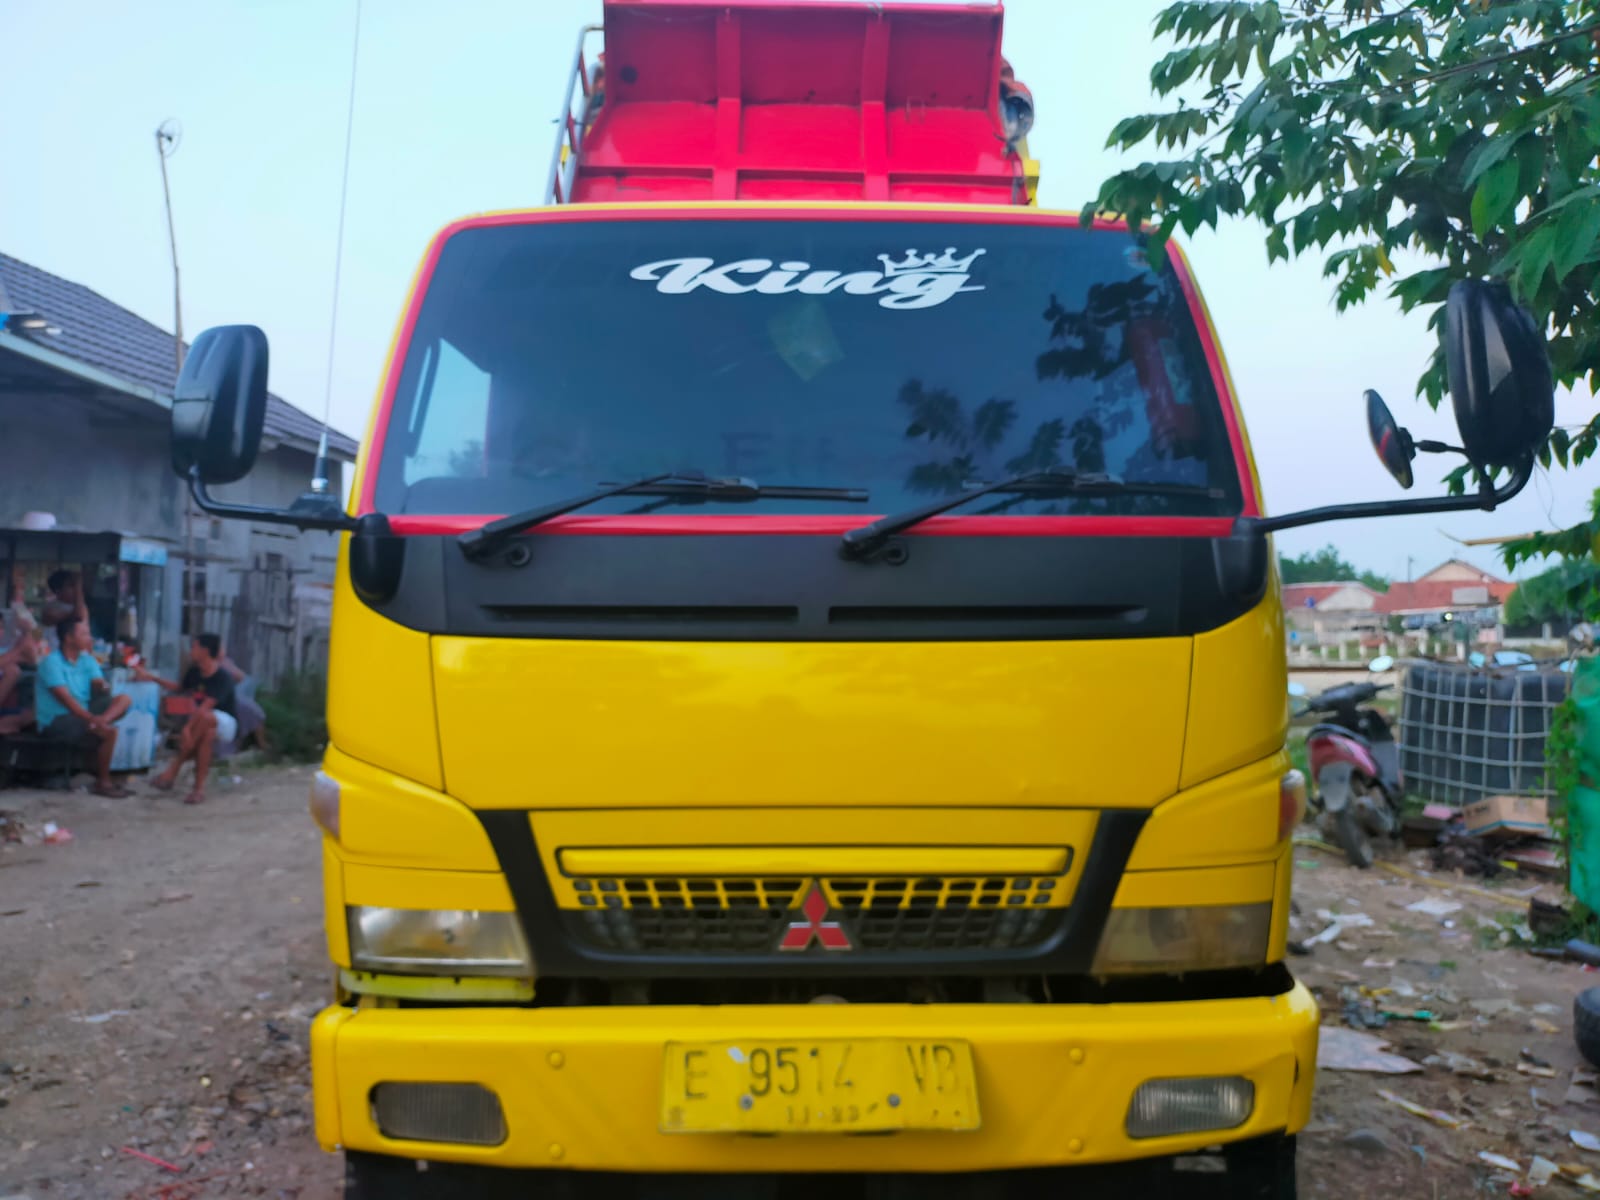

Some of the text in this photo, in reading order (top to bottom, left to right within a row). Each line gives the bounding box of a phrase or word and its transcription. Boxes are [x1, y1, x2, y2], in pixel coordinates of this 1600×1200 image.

[630, 256, 986, 309] King
[684, 1050, 707, 1099] E
[905, 1043, 960, 1094] VB
